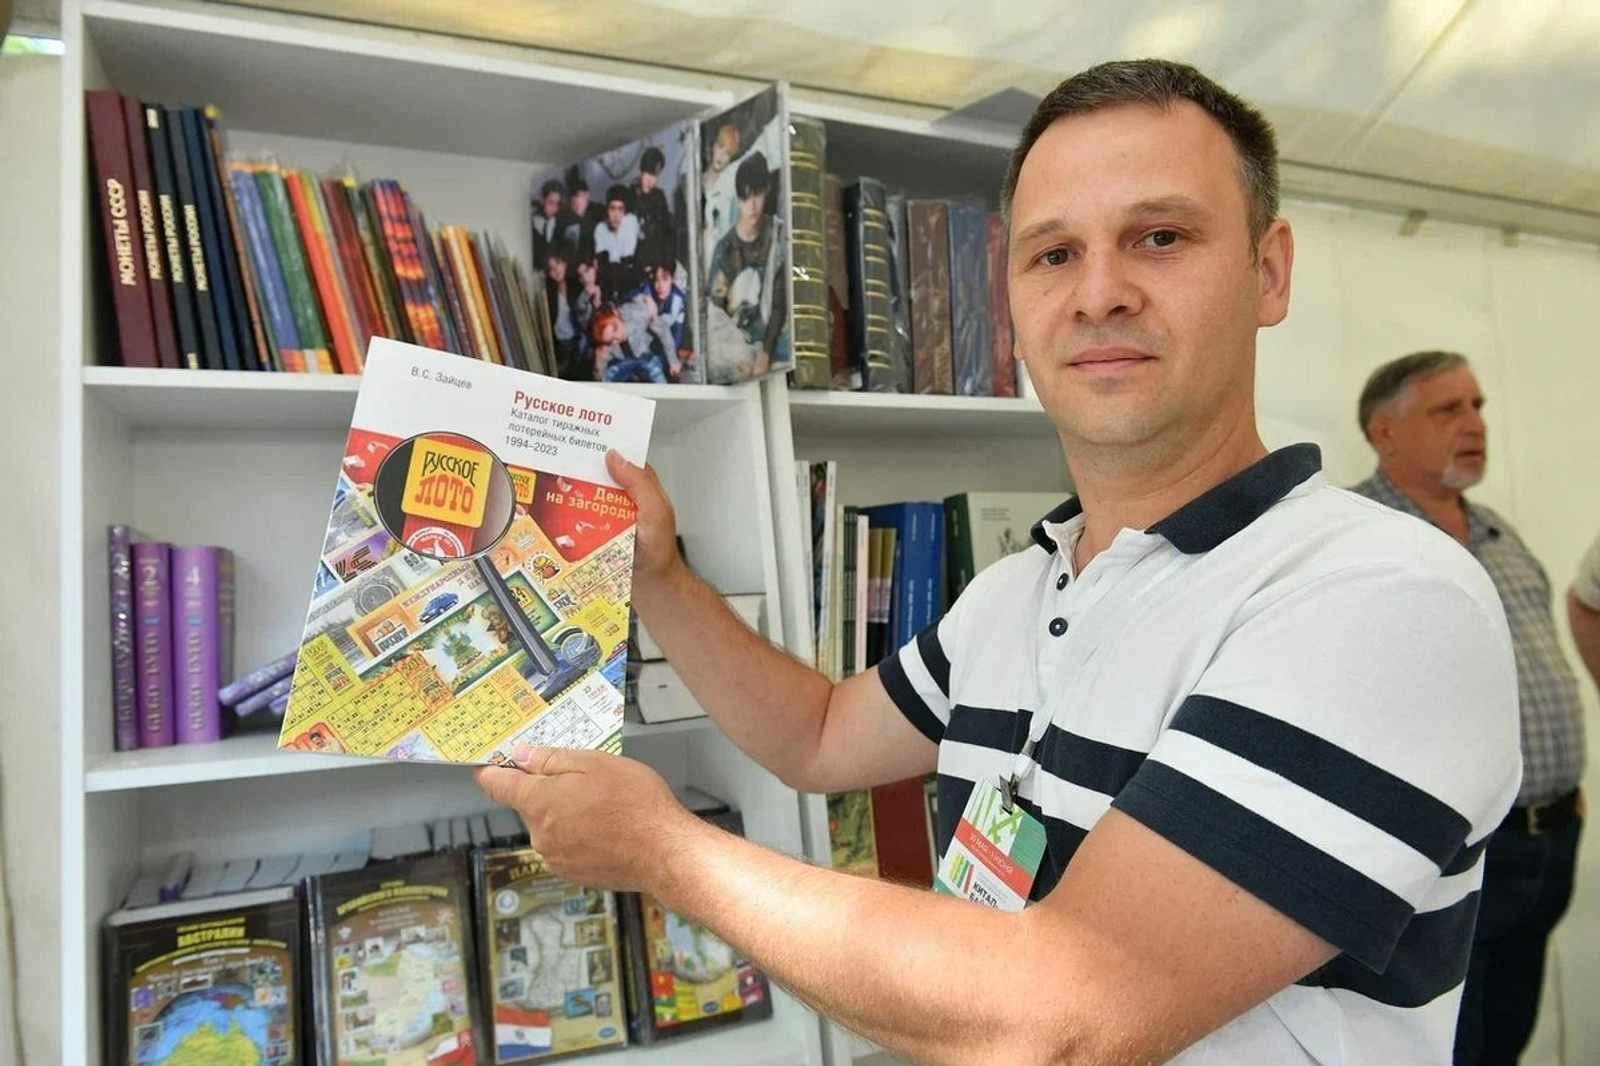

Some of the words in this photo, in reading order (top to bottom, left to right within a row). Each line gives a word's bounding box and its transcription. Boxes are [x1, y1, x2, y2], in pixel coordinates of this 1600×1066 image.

[411, 365, 432, 381] В.С.
[434, 372, 472, 390] Зайцев
[514, 390, 574, 417] Русское
[578, 408, 612, 426] лото
[510, 408, 549, 424] Каталог
[552, 417, 600, 437] тиражных
[568, 432, 608, 452] билетов
[421, 451, 479, 487] РУССКОЕ
[414, 474, 474, 514] ЛОТО
[546, 491, 562, 504] на
[594, 487, 635, 508] День
